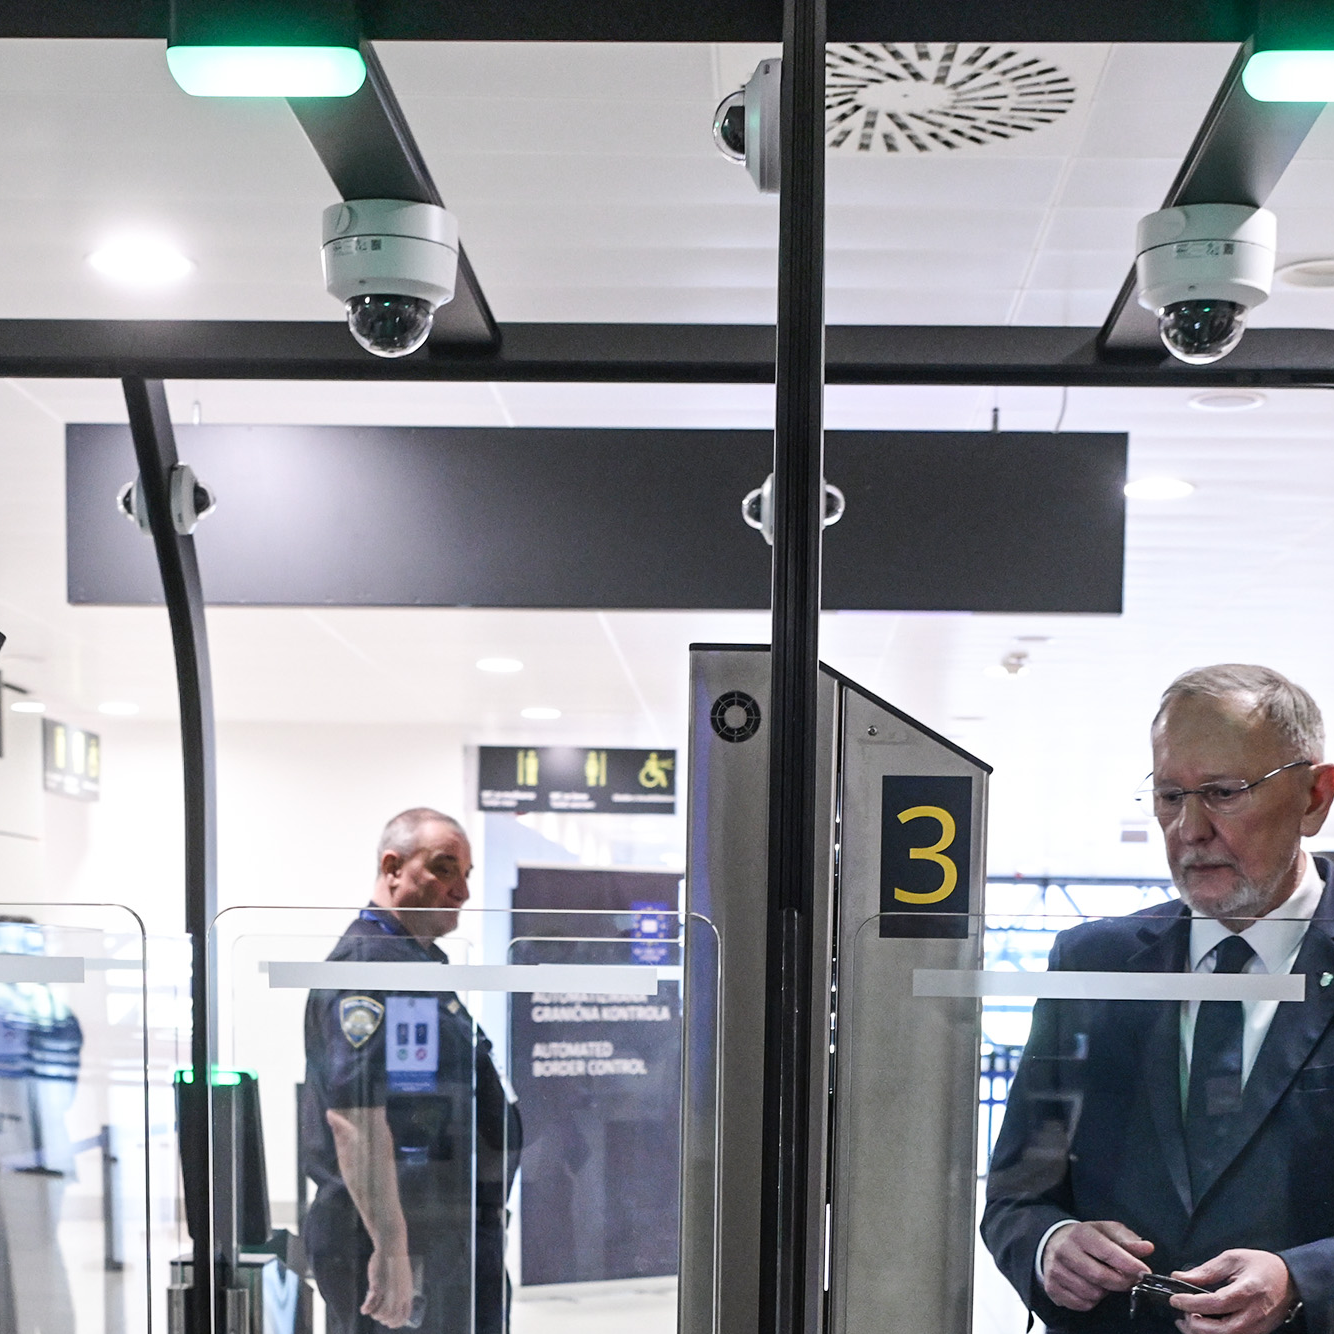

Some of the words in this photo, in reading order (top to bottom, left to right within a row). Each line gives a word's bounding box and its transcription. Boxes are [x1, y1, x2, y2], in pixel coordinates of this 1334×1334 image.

[894, 805, 958, 905] 3
[601, 1005, 671, 1022] KONTROLA
[532, 1041, 614, 1058] AUTOMATED
[532, 1058, 585, 1077] BORDER
[587, 1058, 648, 1076] CONTROL
